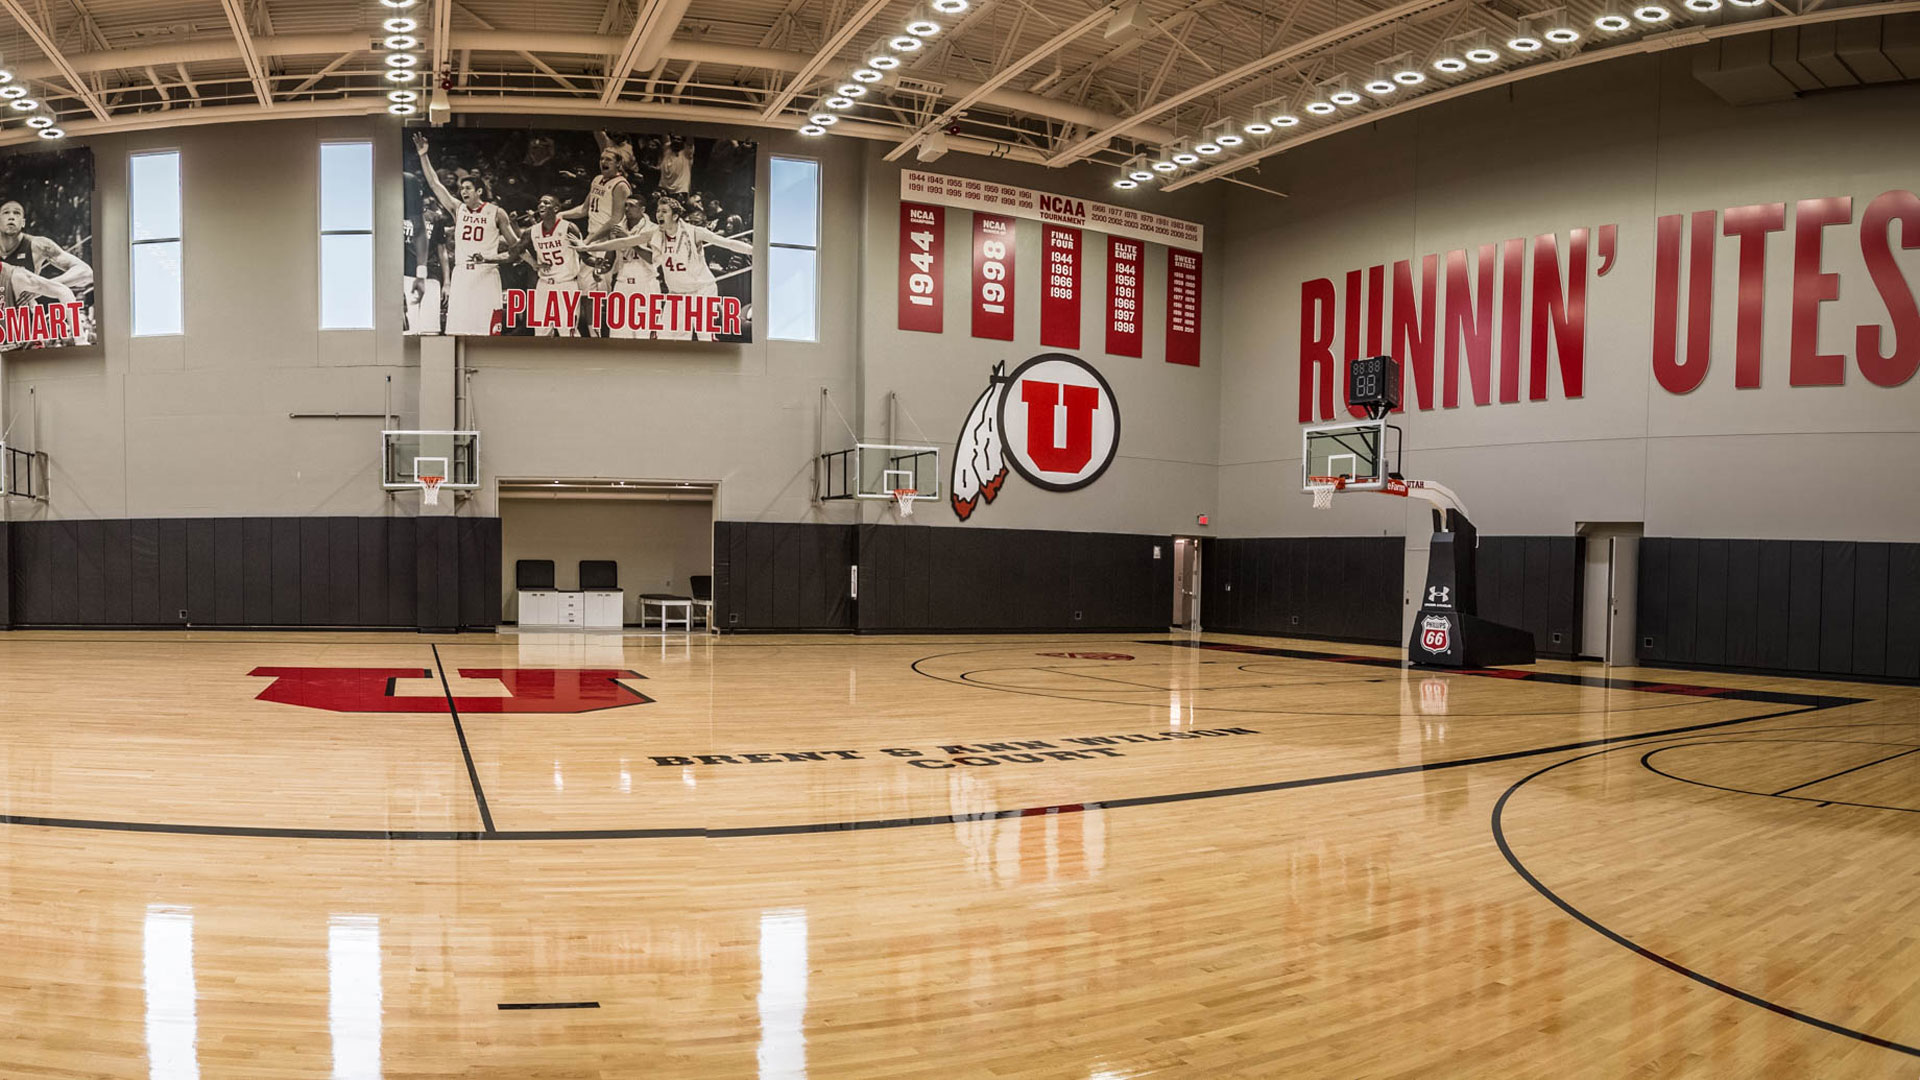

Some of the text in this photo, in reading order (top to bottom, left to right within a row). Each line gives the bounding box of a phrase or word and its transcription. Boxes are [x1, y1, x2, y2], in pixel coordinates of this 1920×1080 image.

[909, 173, 925, 182] 1944
[927, 175, 943, 185] 1945
[984, 194, 998, 204] 1997
[1039, 194, 1086, 218] NCAA
[1108, 207, 1123, 216] 1977
[462, 216, 487, 224] UTAH
[910, 209, 934, 220] NCAA
[1040, 212, 1086, 226] TOURNAMENT
[983, 219, 1006, 231] NCAA
[462, 226, 484, 242] 20
[1051, 231, 1074, 241] FINAL
[537, 240, 562, 250] UTAH
[1051, 239, 1073, 250] FOUR
[1115, 243, 1137, 253] ELITE
[543, 250, 565, 268] 55
[1052, 252, 1072, 264] 1944
[1115, 251, 1137, 261] EIGHT
[1174, 254, 1196, 264] SWEET
[909, 231, 934, 306] 1944
[1051, 263, 1072, 276] 1961
[1116, 263, 1135, 275] 1944
[982, 240, 1006, 314] 1998
[1051, 275, 1072, 288] 1966
[1115, 274, 1135, 287] 1956
[1051, 287, 1072, 300] 1998
[1115, 286, 1135, 298] 1961
[1652, 189, 1920, 395] UTES
[1115, 298, 1135, 310] 1966
[506, 288, 742, 335] PLAY TOGETHER
[1114, 309, 1135, 321] 1997
[1114, 321, 1135, 333] 1998
[1022, 380, 1099, 474] U
[1406, 480, 1424, 489] UTAH
[1426, 631, 1444, 645] 66
[648, 727, 1261, 766] BRENT & ANN WILSON
[906, 748, 1126, 769] COURT
